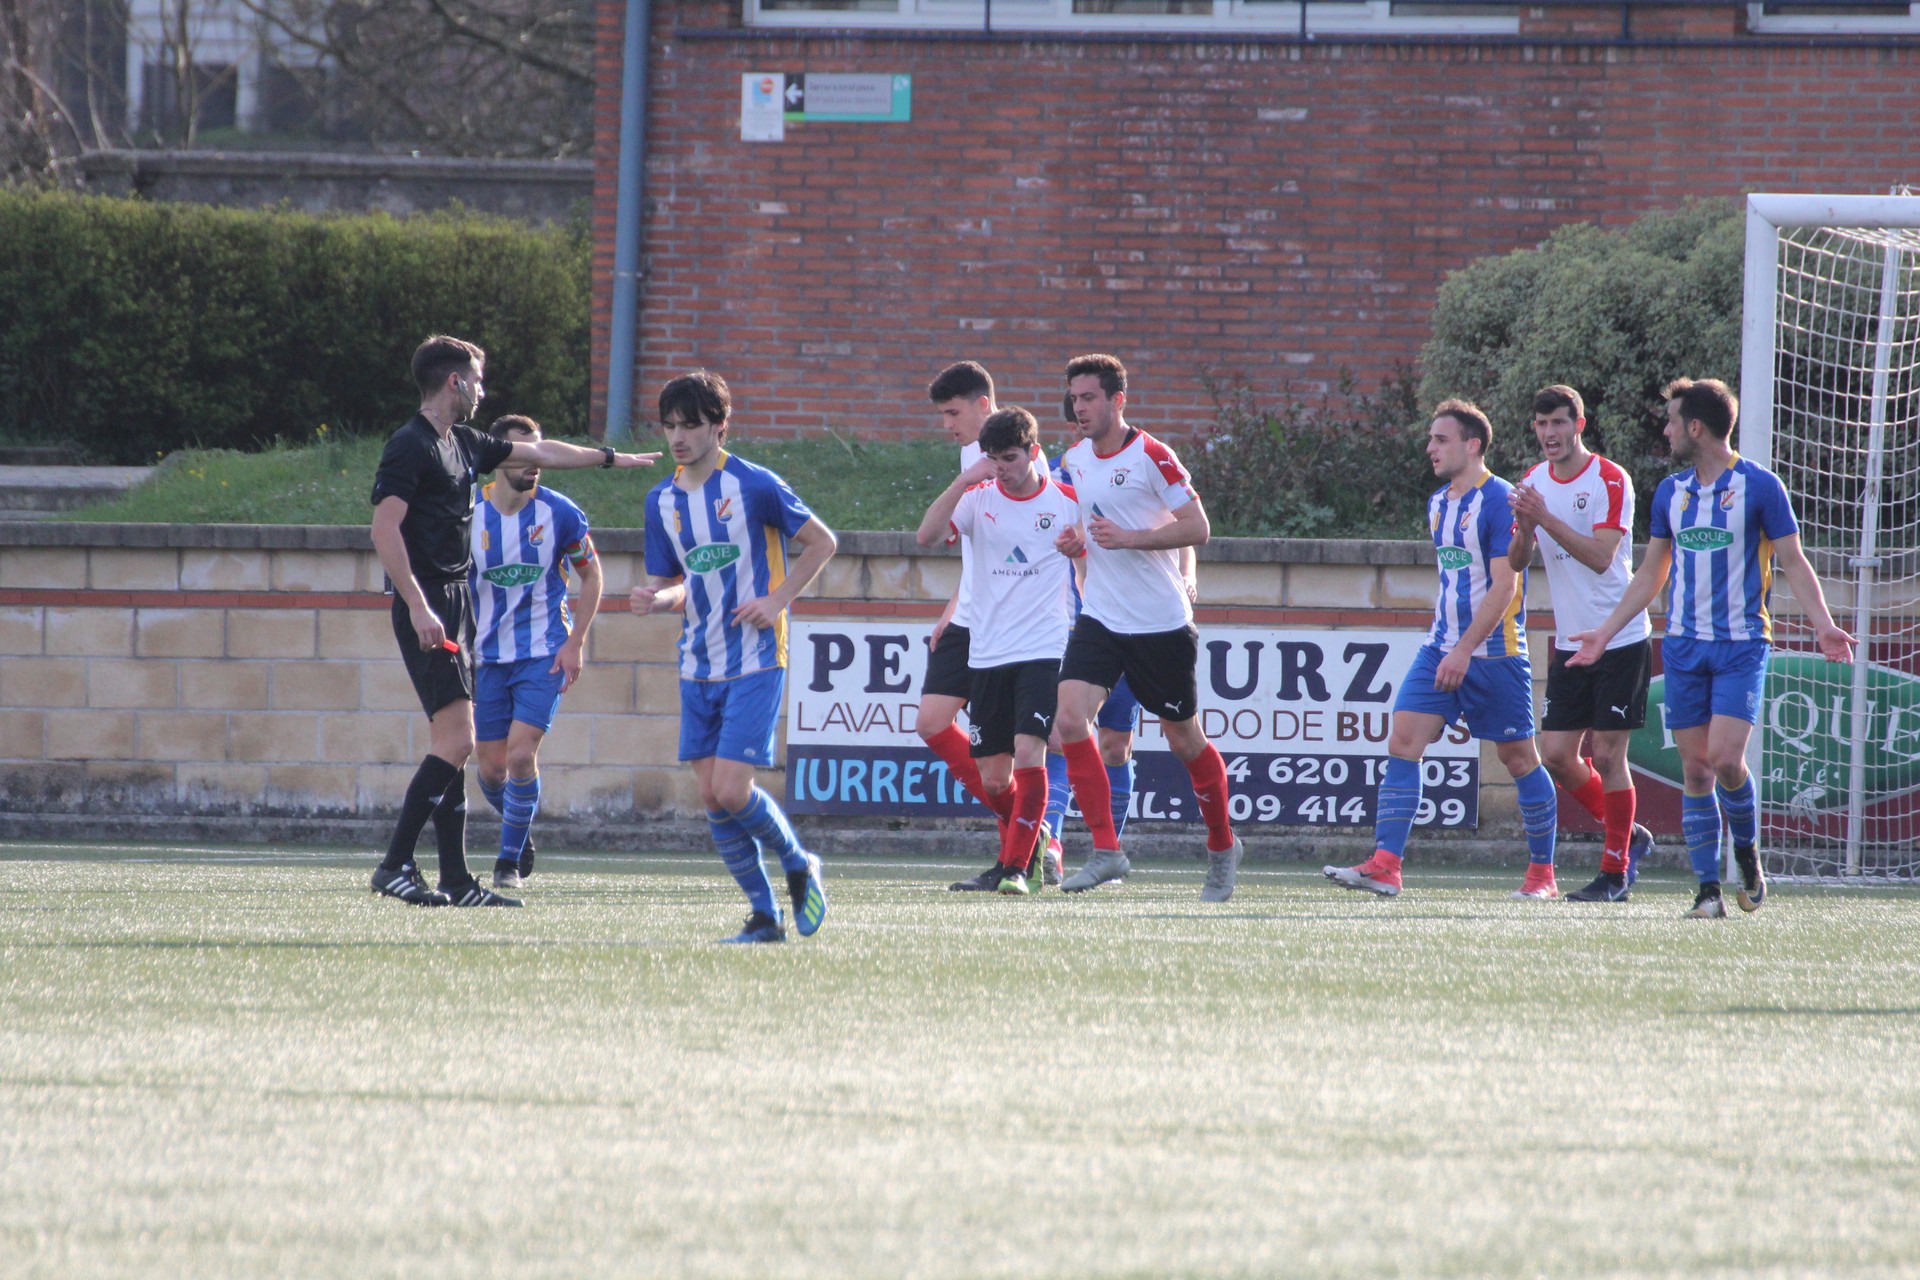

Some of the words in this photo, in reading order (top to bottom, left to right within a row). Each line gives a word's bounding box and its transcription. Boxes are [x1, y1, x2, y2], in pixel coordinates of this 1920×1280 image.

[992, 568, 1040, 577] AMENABAR
[808, 633, 932, 694] PE
[797, 701, 957, 734] LAVAD
[1272, 709, 1324, 742] DE
[1268, 757, 1349, 785] 620
[1297, 795, 1367, 823] 414
[1414, 797, 1466, 826] 99
